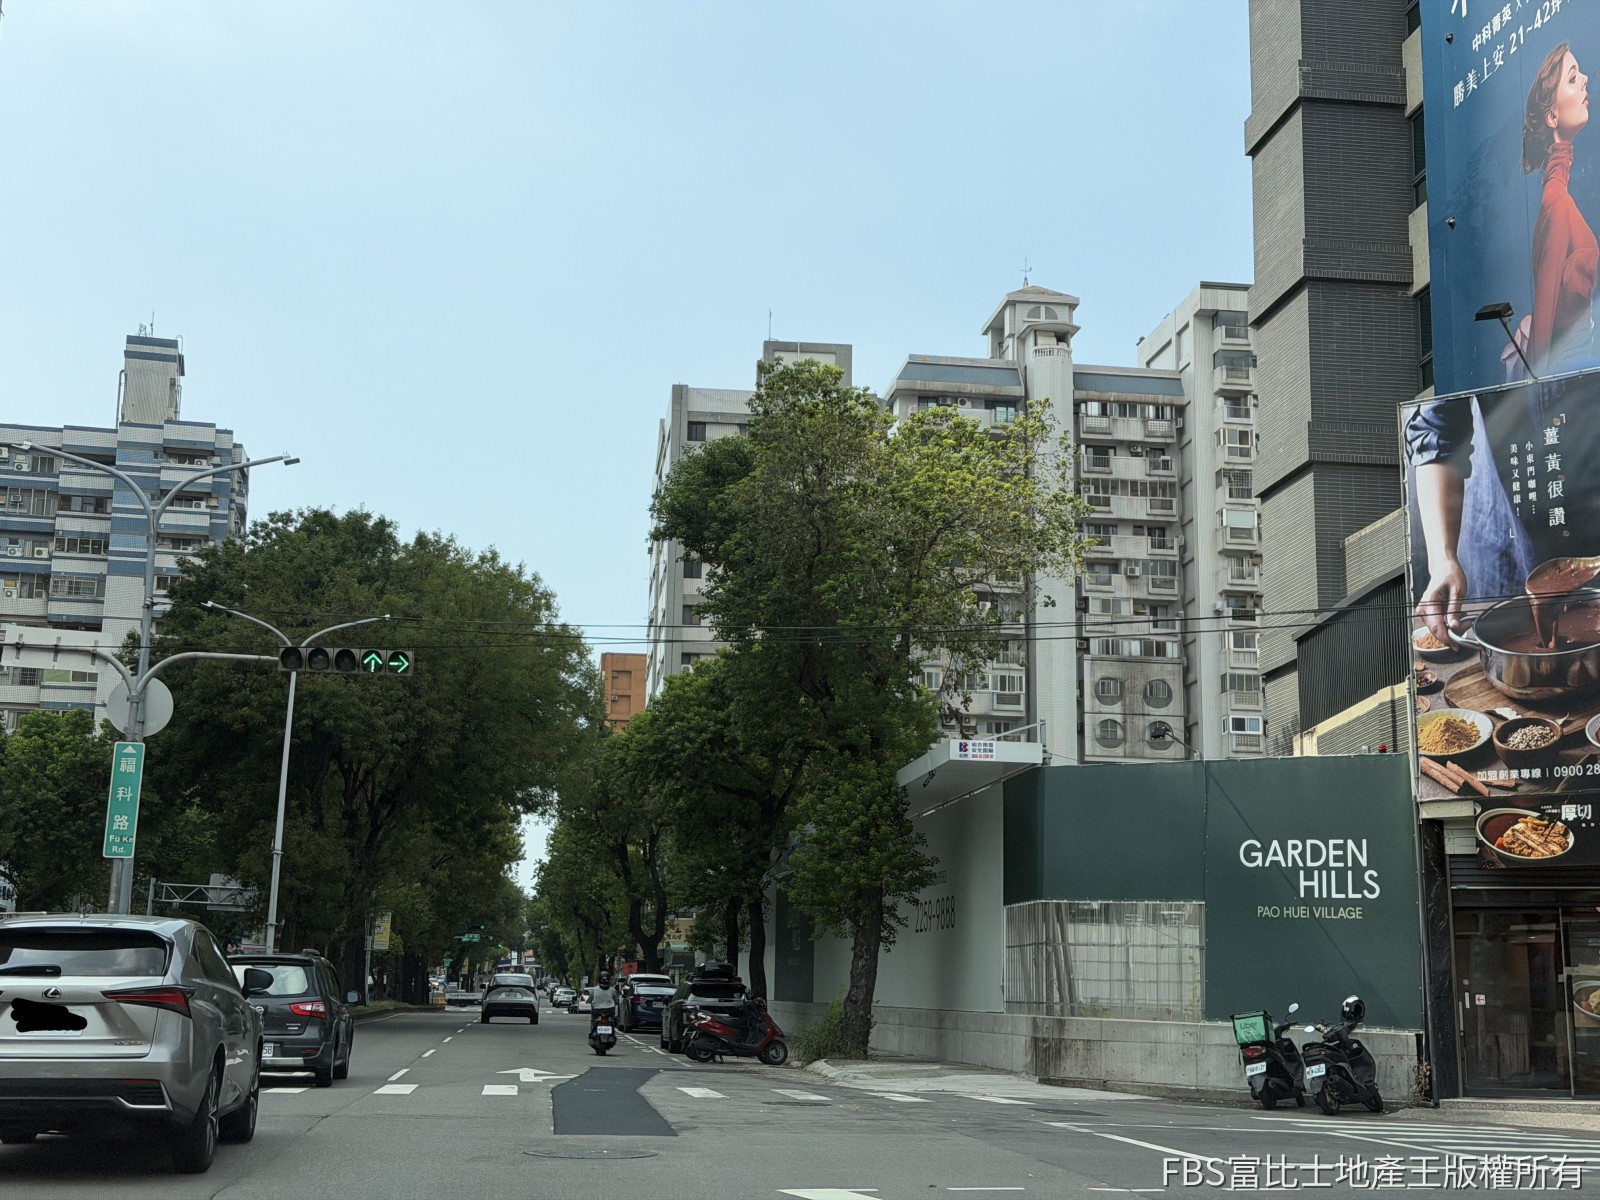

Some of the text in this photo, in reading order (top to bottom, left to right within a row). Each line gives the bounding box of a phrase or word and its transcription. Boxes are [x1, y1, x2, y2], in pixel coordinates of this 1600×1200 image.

[1477, 768, 1541, 781] 加盟創業專線
[1554, 766, 1583, 777] 0900
[113, 757, 136, 831] 福科路
[1561, 804, 1592, 821] 厚切
[109, 834, 134, 843] Fu Ke
[112, 845, 126, 854] Rd.
[1239, 839, 1368, 868] GARDEN
[1299, 869, 1381, 899] HILLS
[1257, 905, 1363, 919] PAO HUEI VILLAGE
